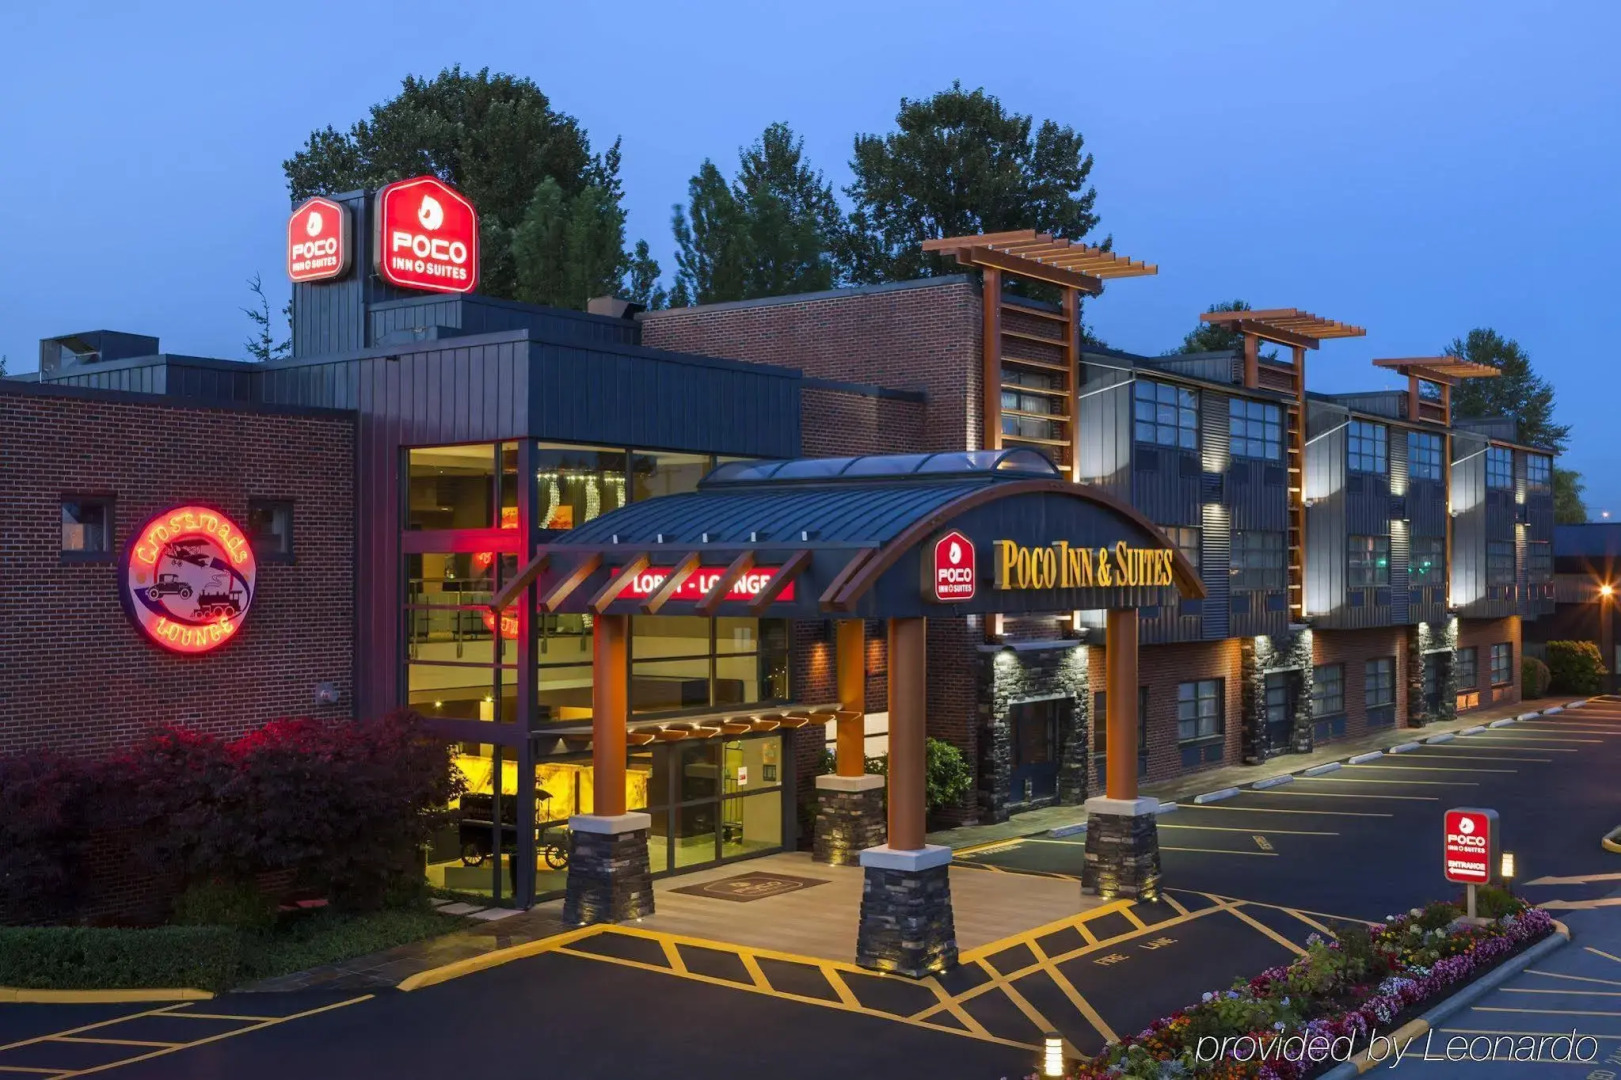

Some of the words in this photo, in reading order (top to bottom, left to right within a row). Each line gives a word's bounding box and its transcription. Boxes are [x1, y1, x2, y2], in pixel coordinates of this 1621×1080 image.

[293, 237, 337, 260] POCO
[393, 231, 467, 264] POCO
[292, 262, 305, 272] INN
[311, 256, 337, 269] SUITES
[392, 257, 413, 272] INN
[426, 262, 467, 280] SUITES
[137, 513, 248, 564] Crossroads
[938, 567, 972, 583] POCO
[1098, 547, 1113, 587] &
[699, 574, 771, 594] LONGE
[938, 585, 948, 593] INN
[954, 584, 972, 593] SUITES
[157, 616, 234, 646] LOUNGE
[1447, 834, 1486, 847] POCO
[1464, 846, 1486, 854] SUITES
[1447, 860, 1486, 870] ENTRANCE
